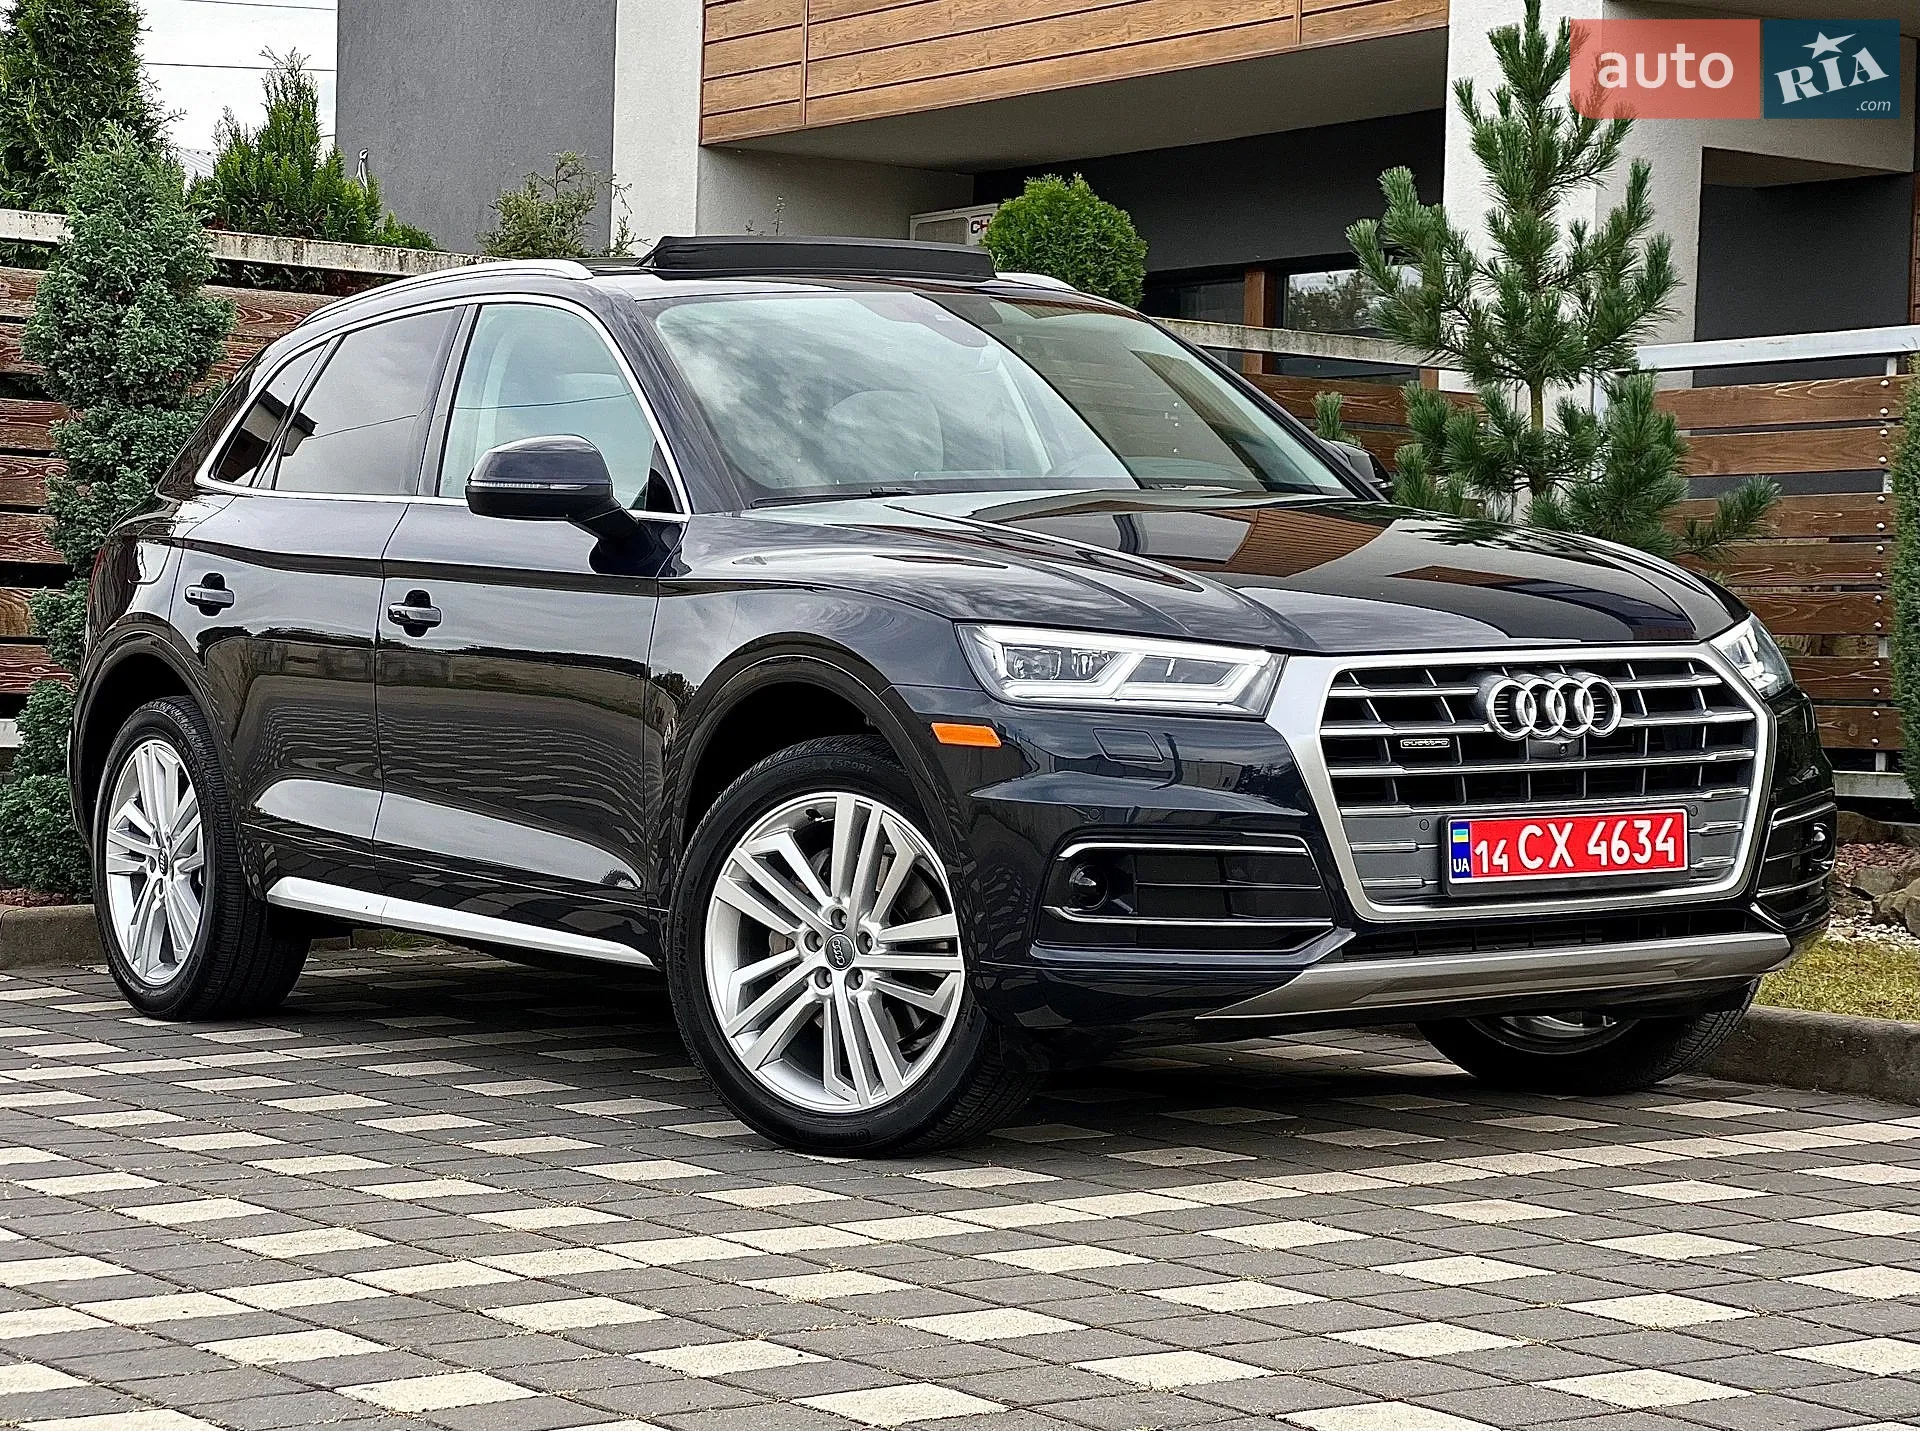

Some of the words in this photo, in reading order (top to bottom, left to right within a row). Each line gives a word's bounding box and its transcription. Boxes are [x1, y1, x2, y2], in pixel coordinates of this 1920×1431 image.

[1473, 839, 1509, 873] 14
[1517, 822, 1575, 870] CX
[1587, 818, 1675, 866] 4634
[1453, 858, 1470, 873] UA
